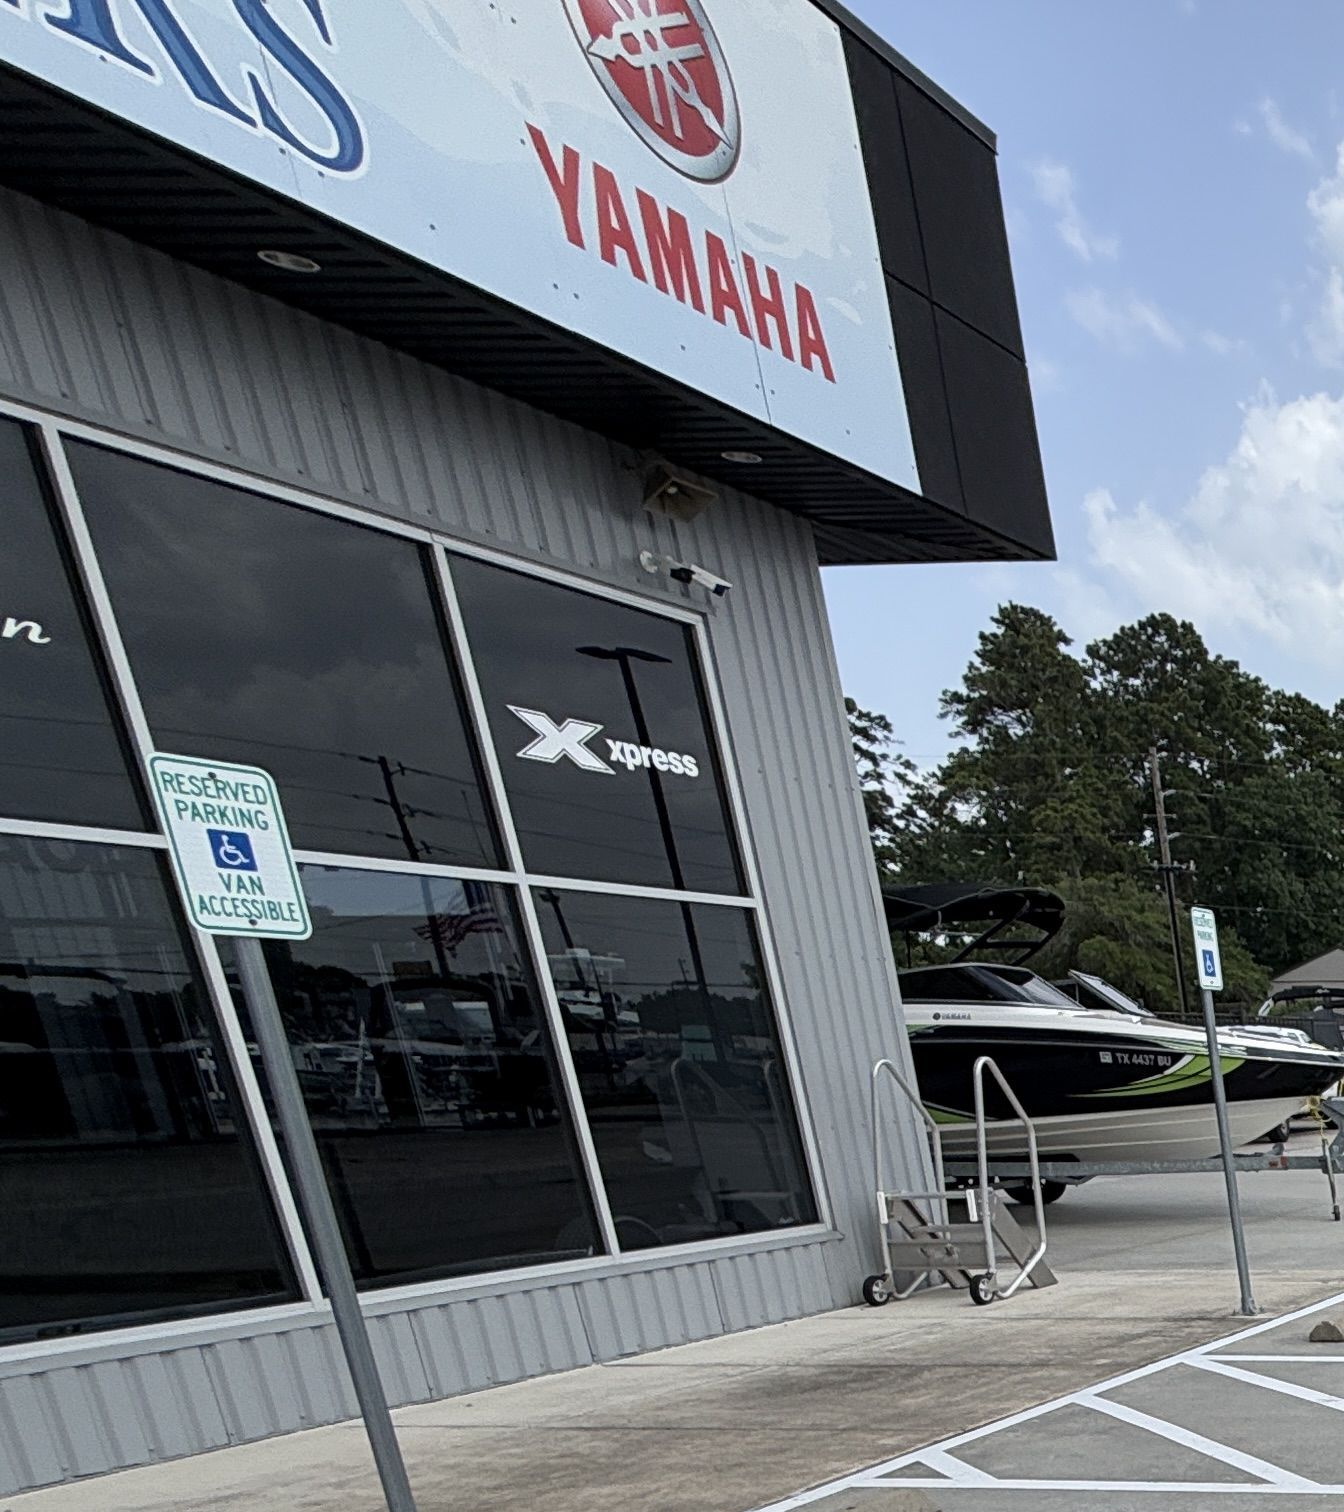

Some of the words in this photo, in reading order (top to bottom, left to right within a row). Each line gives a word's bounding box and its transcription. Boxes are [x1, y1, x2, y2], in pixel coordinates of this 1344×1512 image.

[525, 121, 836, 384] YAMAHA
[604, 738, 699, 777] xpress
[160, 771, 267, 805] RESERVED
[174, 799, 269, 830] PARKING
[218, 872, 265, 896] VAN
[199, 895, 300, 922] ACCESSIBLE
[1115, 1053, 1130, 1064] TX
